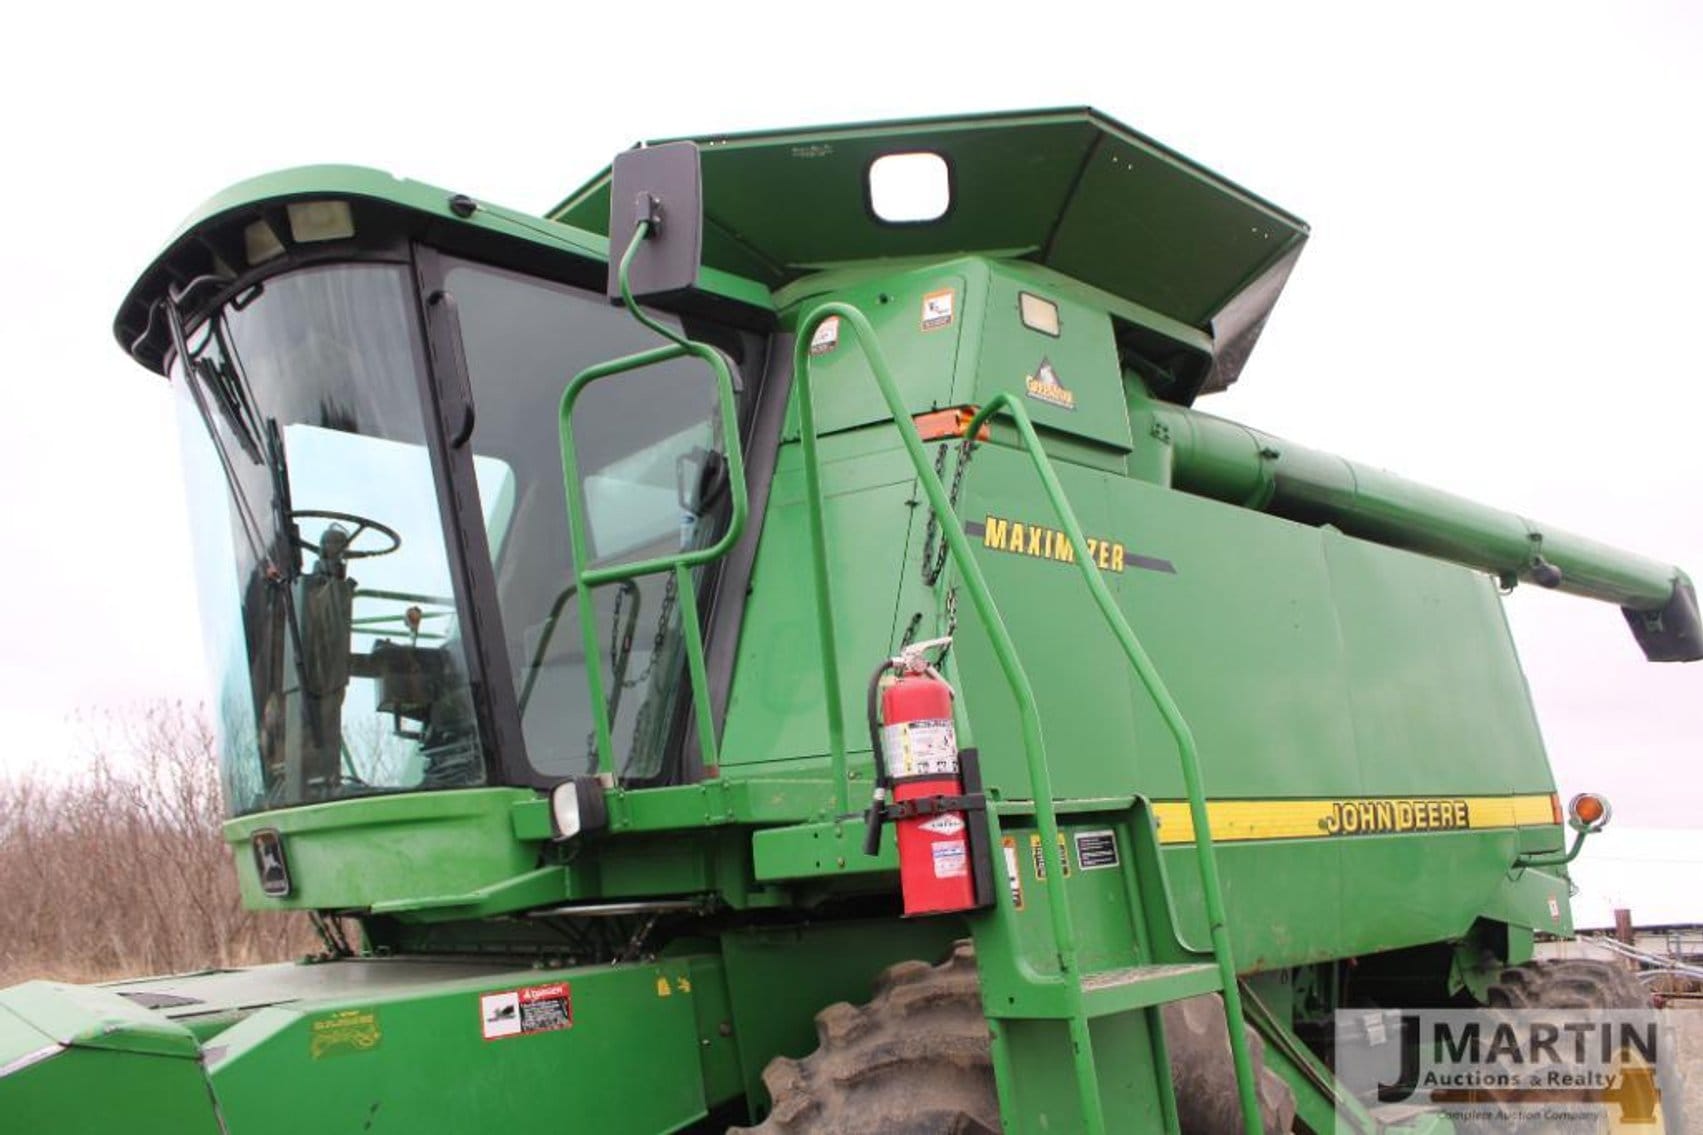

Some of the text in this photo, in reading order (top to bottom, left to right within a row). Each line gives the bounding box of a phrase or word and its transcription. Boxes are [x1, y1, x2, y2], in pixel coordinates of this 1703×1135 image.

[984, 514, 1124, 573] MAXIMZER
[1326, 800, 1469, 835] JOHN DEERE
